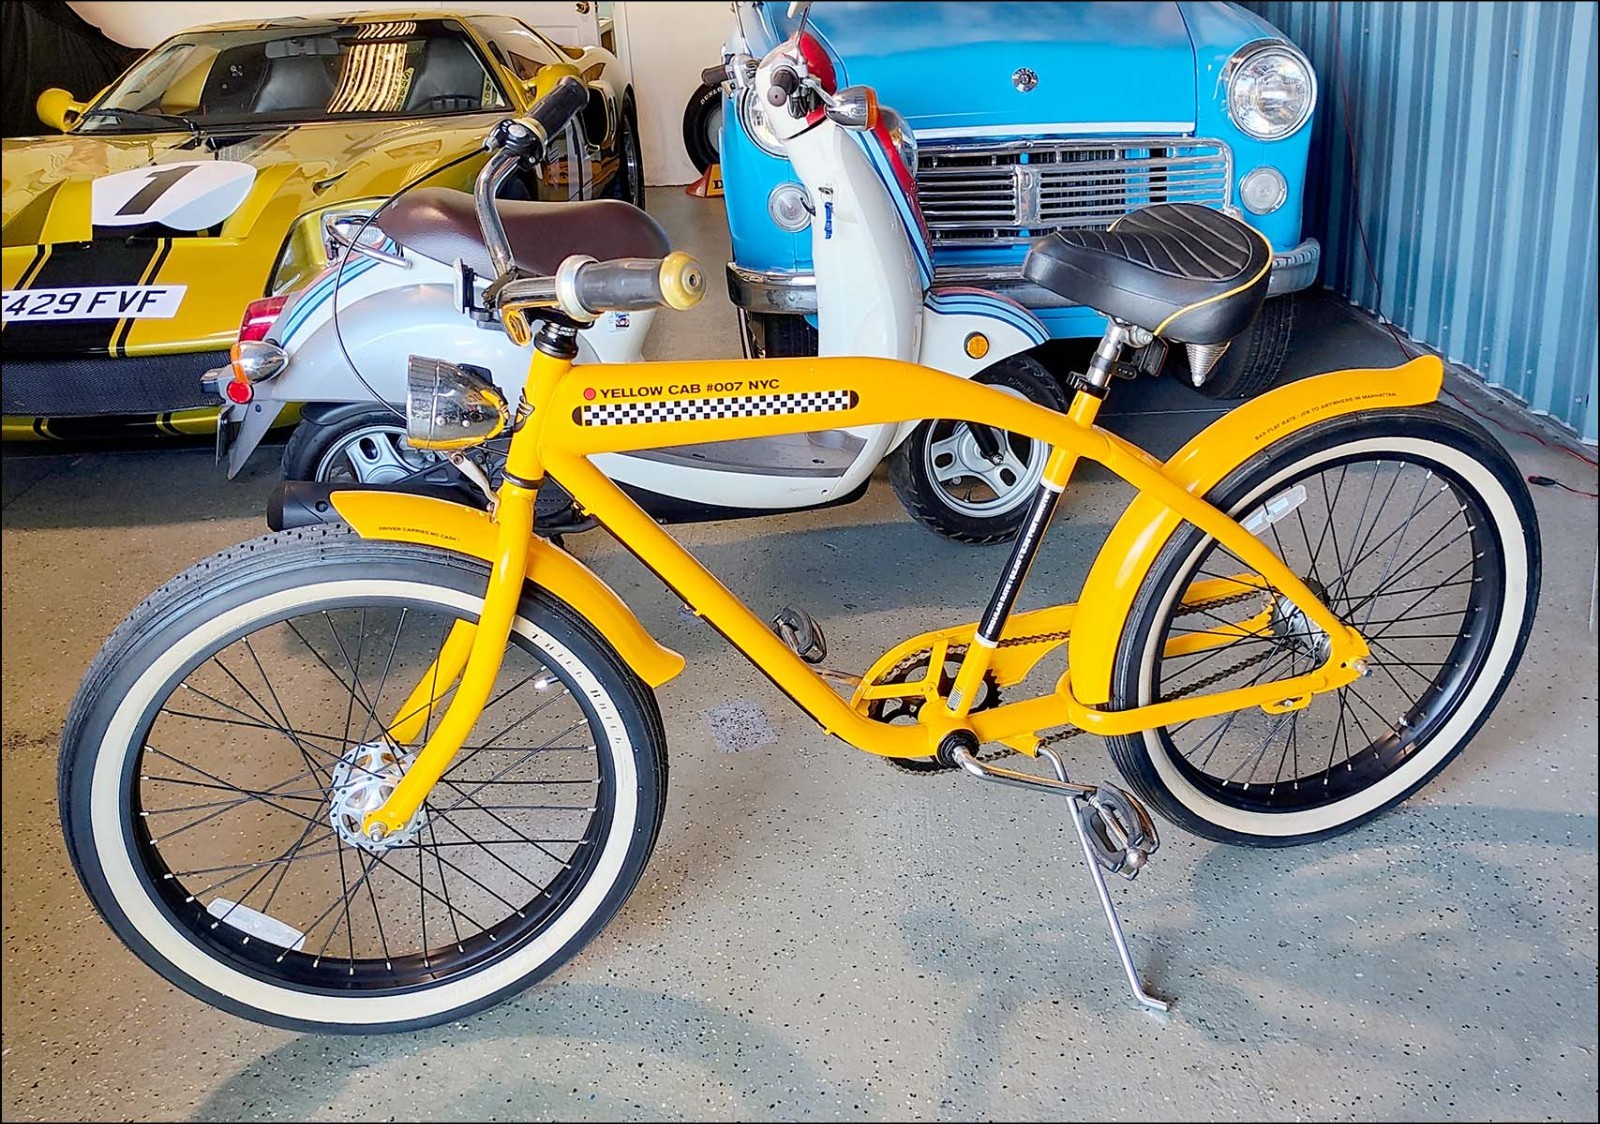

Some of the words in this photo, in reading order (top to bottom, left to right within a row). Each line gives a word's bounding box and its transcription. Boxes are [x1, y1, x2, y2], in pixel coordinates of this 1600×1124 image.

[700, 86, 722, 105] DUNLO
[114, 165, 200, 216] 1
[2, 292, 82, 317] 429
[86, 290, 168, 314] FVF
[600, 385, 664, 400] YELLOW
[668, 383, 701, 395] CAB
[706, 381, 743, 393] #007
[748, 378, 780, 391] NYC
[1320, 397, 1353, 410] ANYWHERE
[402, 526, 429, 535] CARRIES
[985, 601, 1004, 635] REGULAR
[999, 582, 1012, 602] RATE
[1032, 491, 1050, 523] MINUTE
